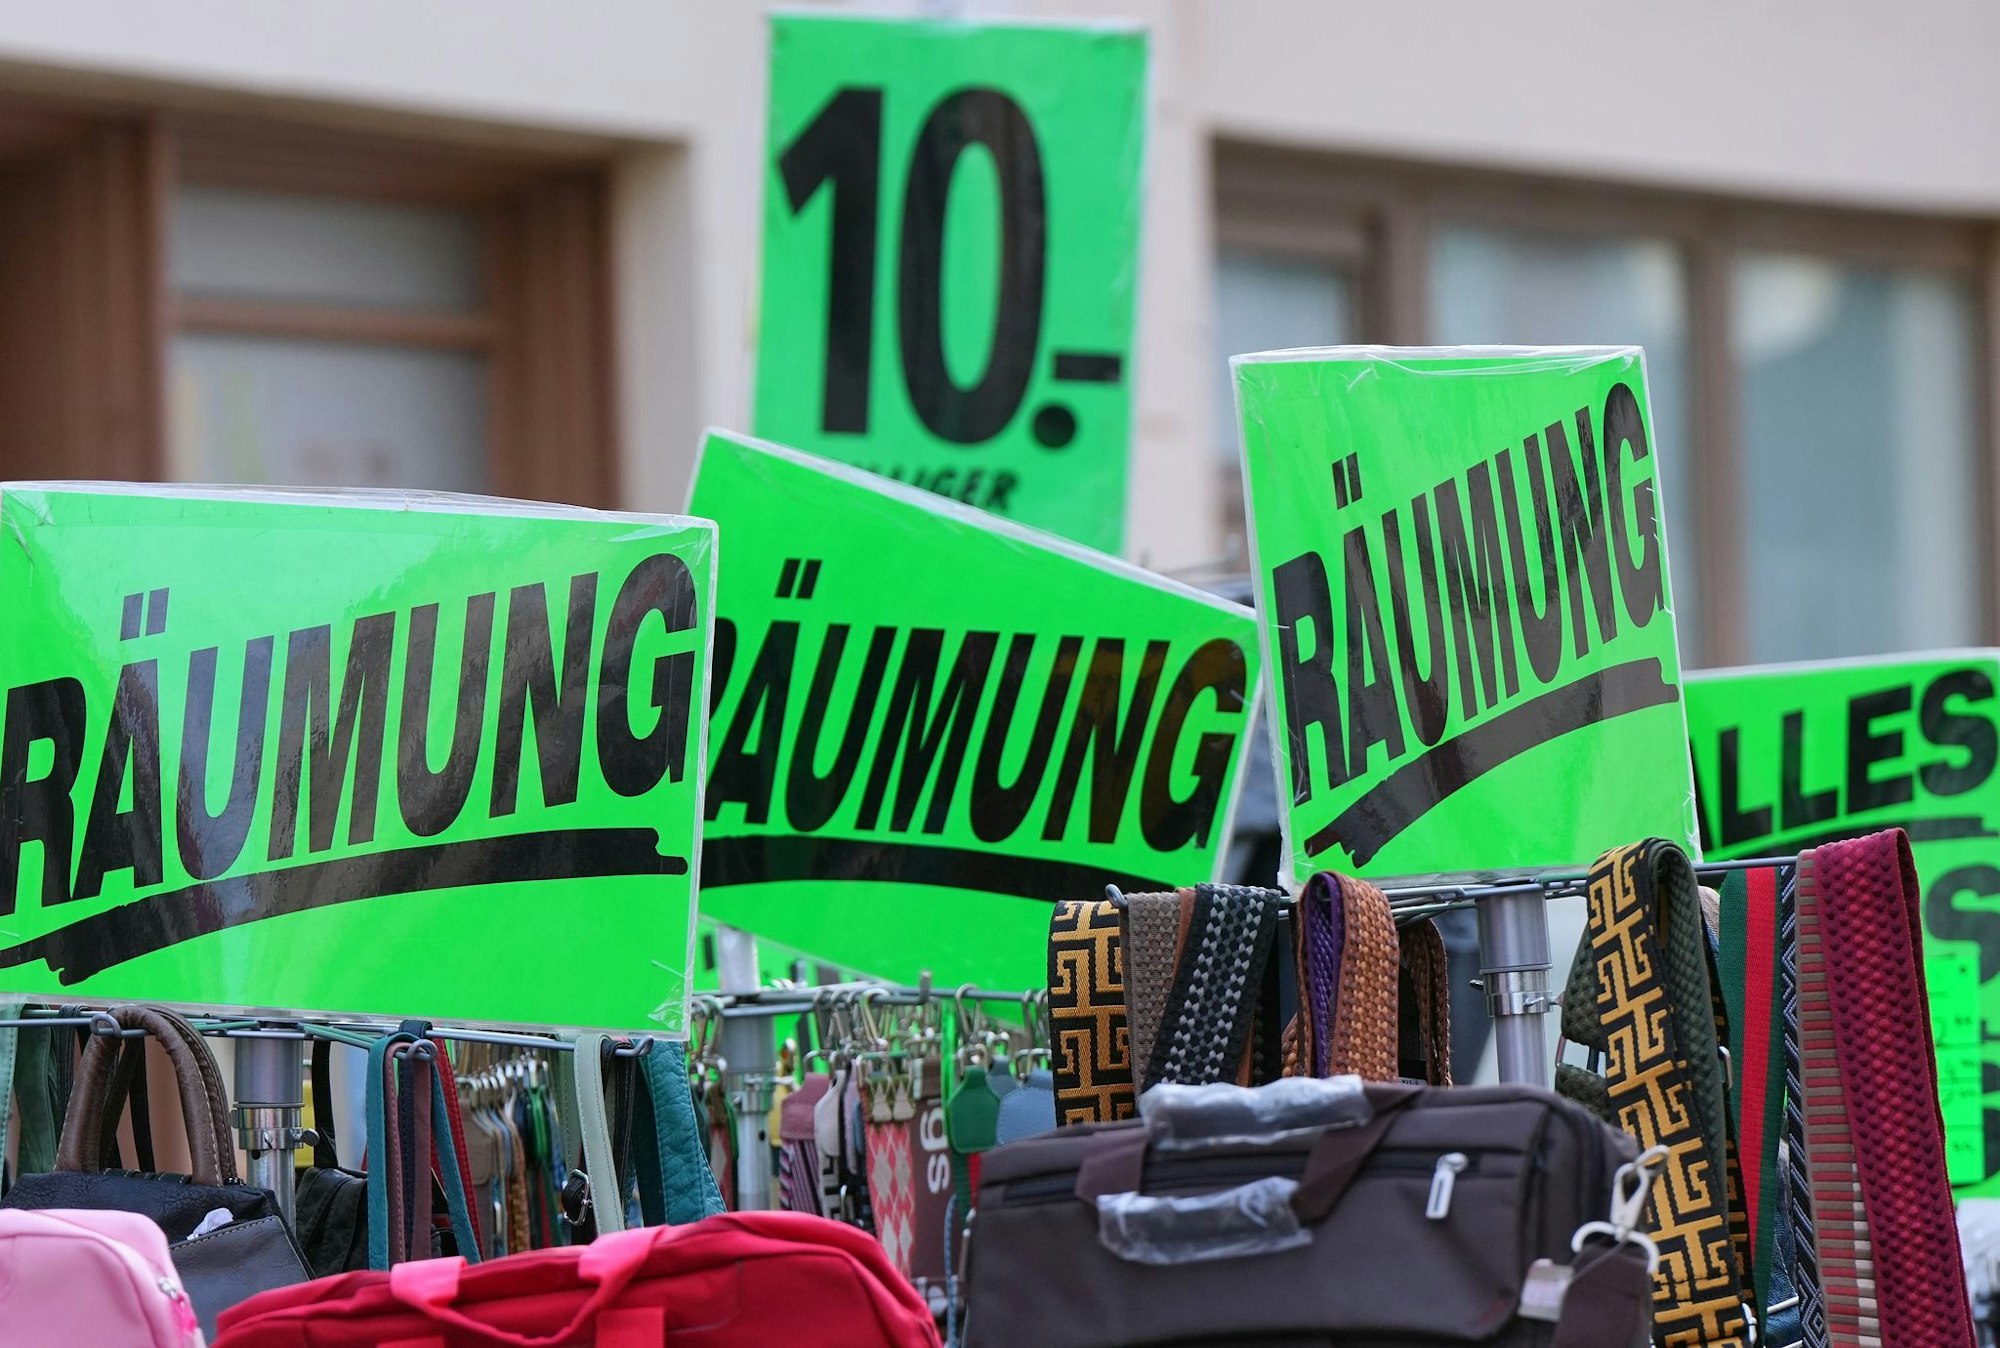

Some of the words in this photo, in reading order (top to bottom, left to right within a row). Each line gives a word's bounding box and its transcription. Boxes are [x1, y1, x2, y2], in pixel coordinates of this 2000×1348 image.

[777, 85, 1122, 449] 10.-
[0, 553, 698, 916] RÄUMUNG
[1272, 382, 1665, 807] RÄUMUNG
